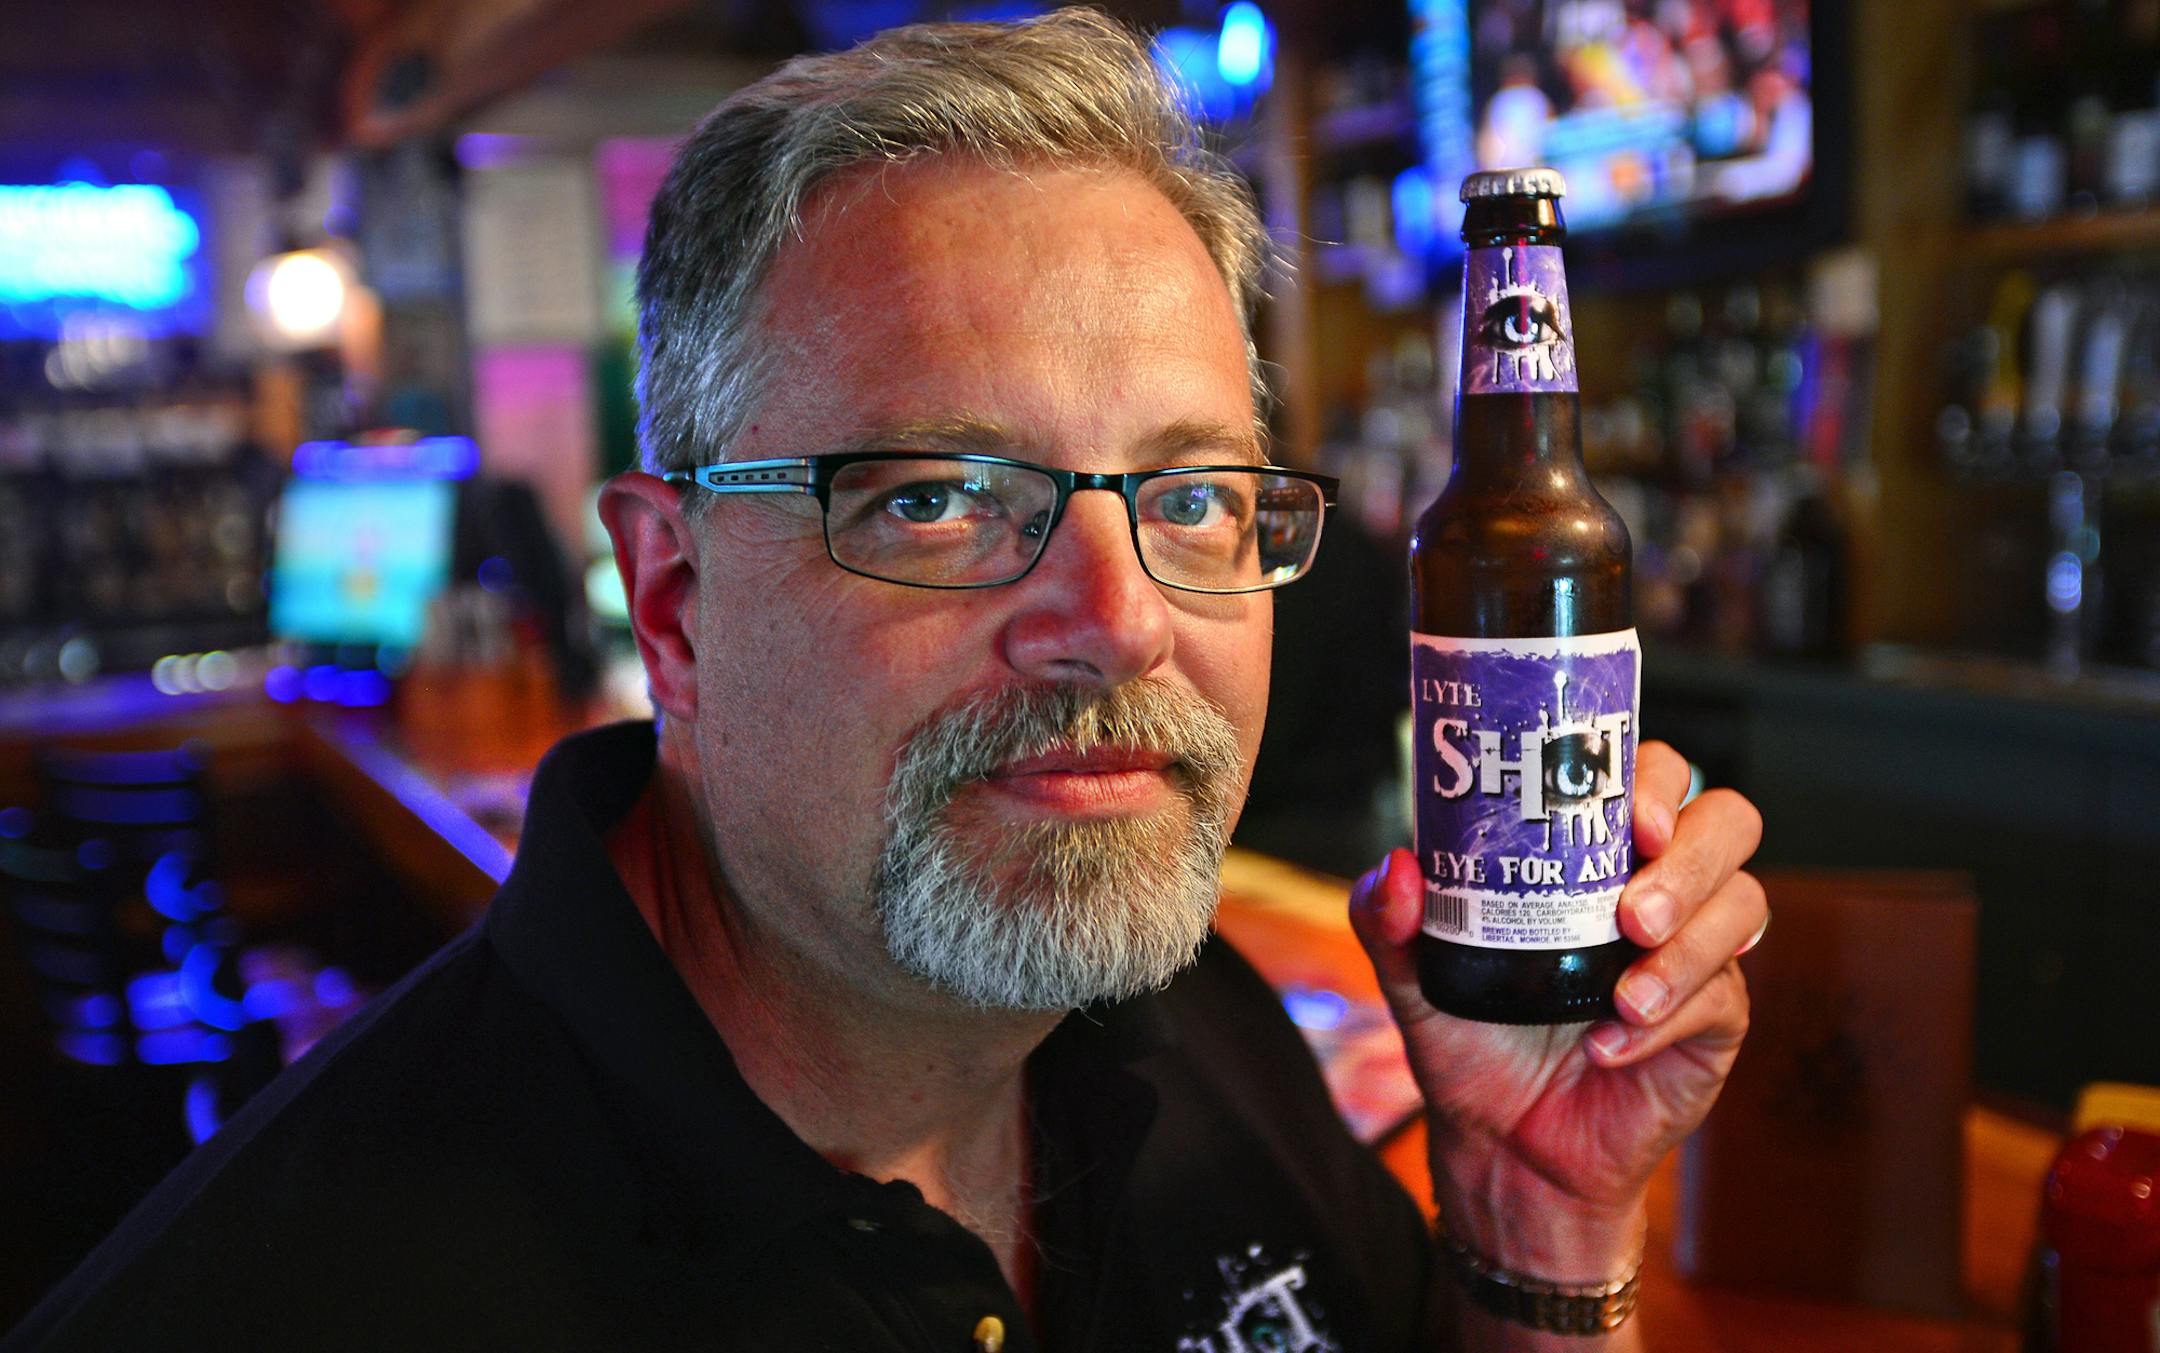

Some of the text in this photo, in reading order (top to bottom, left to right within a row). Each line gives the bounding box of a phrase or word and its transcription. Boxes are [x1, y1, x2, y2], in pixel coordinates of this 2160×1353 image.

[1422, 678, 1482, 708] LYTE
[1433, 851, 1487, 883] EYE
[1498, 856, 1565, 885] FOR
[1481, 899, 1505, 908] BASED
[1508, 901, 1518, 909] ON
[1521, 901, 1554, 909] AVERAGE
[1481, 907, 1517, 917] CALORIES
[1492, 917, 1525, 925] ALCOHOL
[1481, 926, 1511, 935] BREWED
[1512, 928, 1527, 936] AND
[1529, 928, 1562, 936] BOTTLED
